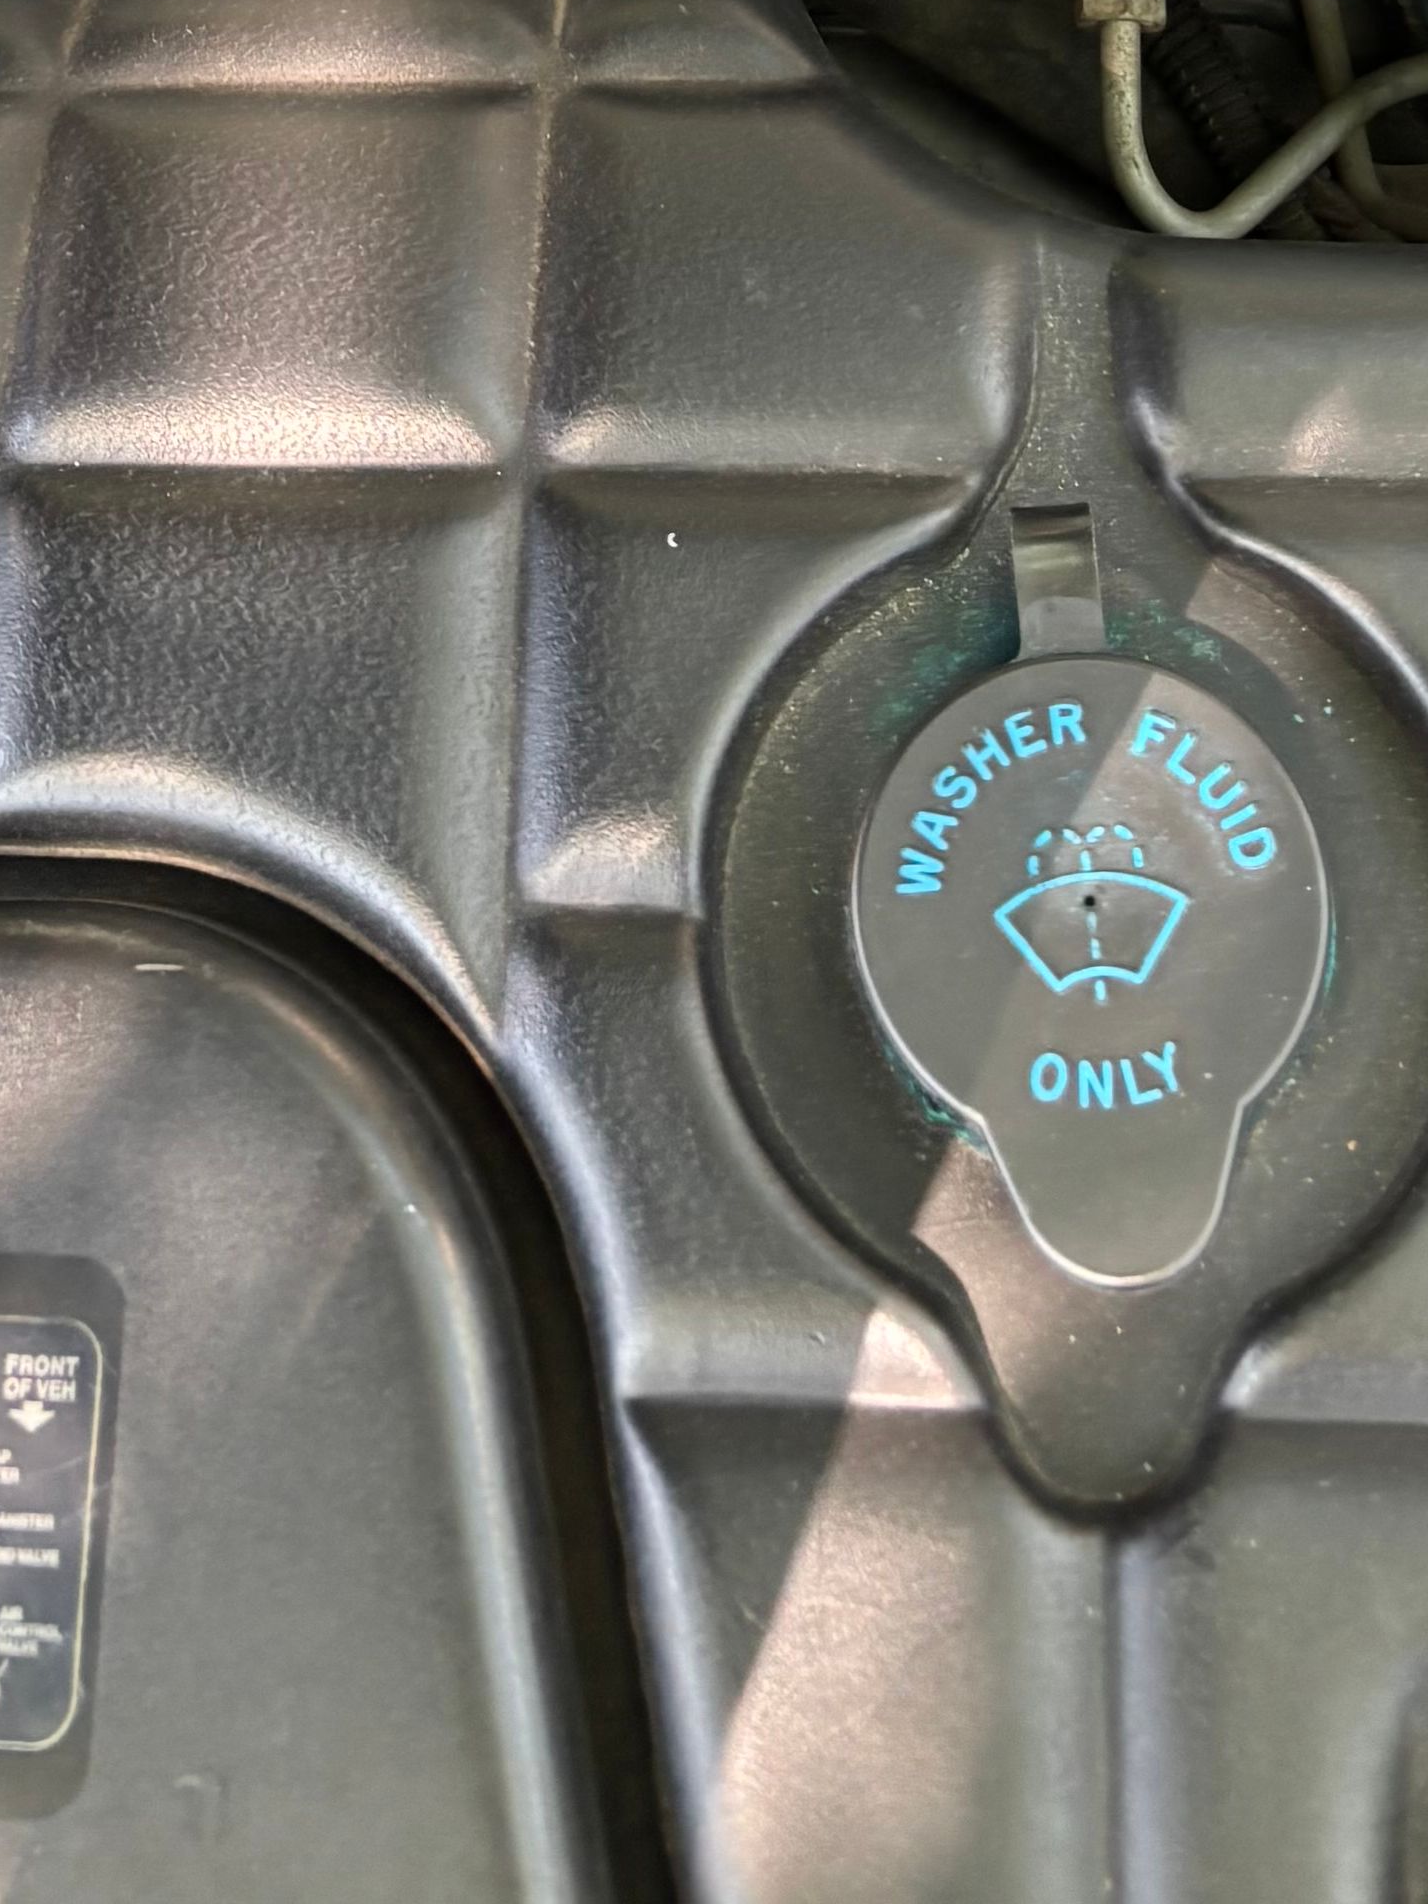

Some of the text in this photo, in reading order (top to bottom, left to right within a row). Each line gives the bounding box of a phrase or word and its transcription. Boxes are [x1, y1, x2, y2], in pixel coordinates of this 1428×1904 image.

[895, 703, 1276, 894] WASHER FLUID
[1029, 1041, 1183, 1109] ONLY
[4, 1353, 80, 1377] FRONT
[3, 1377, 76, 1402] OF VEH
